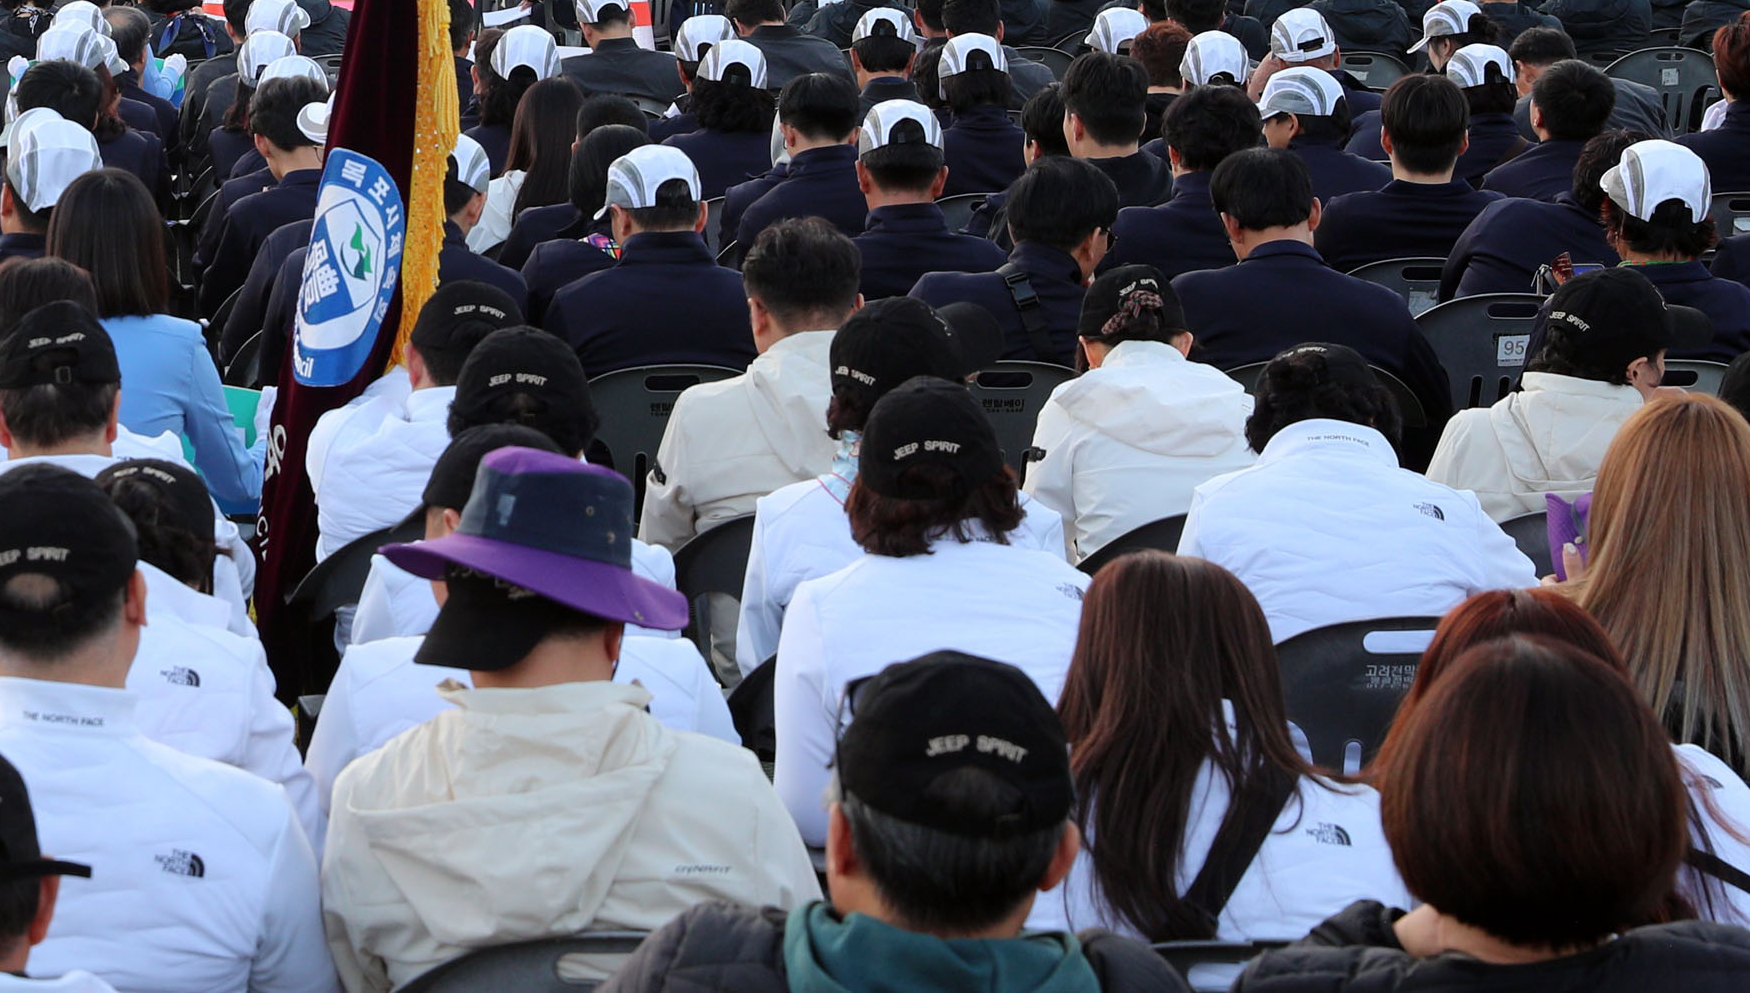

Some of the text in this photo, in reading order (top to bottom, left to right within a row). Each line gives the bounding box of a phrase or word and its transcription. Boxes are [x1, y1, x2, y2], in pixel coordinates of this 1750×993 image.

[453, 304, 506, 319] JEEP SPIRIT
[1549, 311, 1590, 332] JEEP SPIRIT
[28, 332, 87, 349] JEEP SPIRIT
[1503, 340, 1525, 356] 95
[488, 372, 548, 387] JEEP SPIRIT
[851, 368, 877, 387] SPIRIT
[1352, 437, 1370, 447] FACE
[894, 439, 961, 461] JEEP SPIRIT
[26, 546, 70, 562] SPIRIT
[22, 710, 104, 726] THE NORTH FACE
[925, 734, 1028, 764] JEEP SPIRIT
[1306, 829, 1338, 838] NORTH
[1318, 822, 1334, 830] THE
[1316, 836, 1339, 845] FACE
[172, 848, 190, 857] THE
[155, 855, 191, 867] NORTH
[162, 865, 191, 876] FACE
